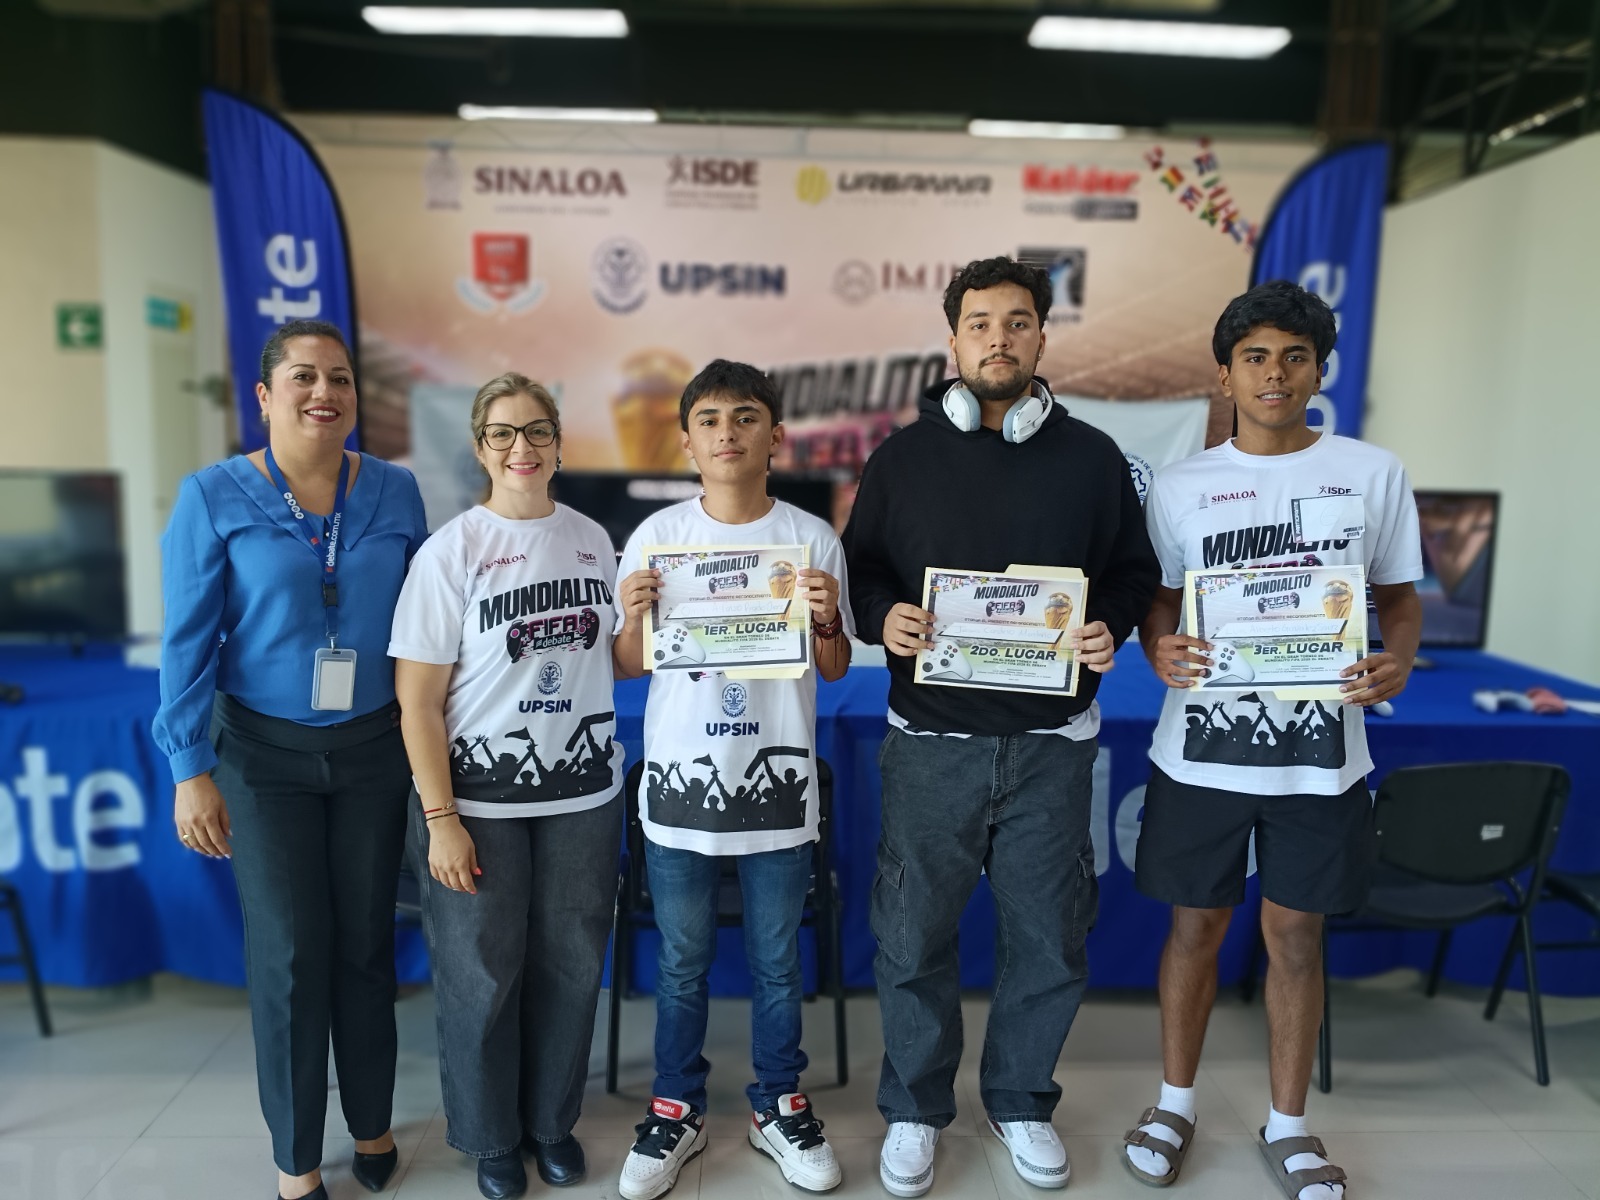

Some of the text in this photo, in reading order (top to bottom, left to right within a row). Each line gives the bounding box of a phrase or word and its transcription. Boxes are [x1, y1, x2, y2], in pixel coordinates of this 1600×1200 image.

[474, 165, 628, 198] SINALOA
[692, 160, 759, 186] ISDE
[658, 263, 786, 296] UPSIN
[766, 354, 947, 421] NDIALITO
[1212, 490, 1256, 502] SINALOA
[326, 512, 341, 567] debate.com.mx
[486, 554, 526, 569] SINALOA
[695, 554, 759, 577] MUNDIALITO
[718, 575, 738, 585] FIFA
[1243, 574, 1312, 597] MUNDIALITO
[973, 584, 1039, 600] MUNDIALITO
[480, 578, 612, 634] MUNDIALITO
[528, 614, 578, 638] FIFA
[704, 621, 788, 636] 1ER. LUGAR
[970, 646, 1057, 660] 2DO. LUGAR
[1254, 642, 1344, 654] 3ER. LUGAR
[518, 699, 572, 714] UPSIN
[706, 722, 759, 736] UPSIN
